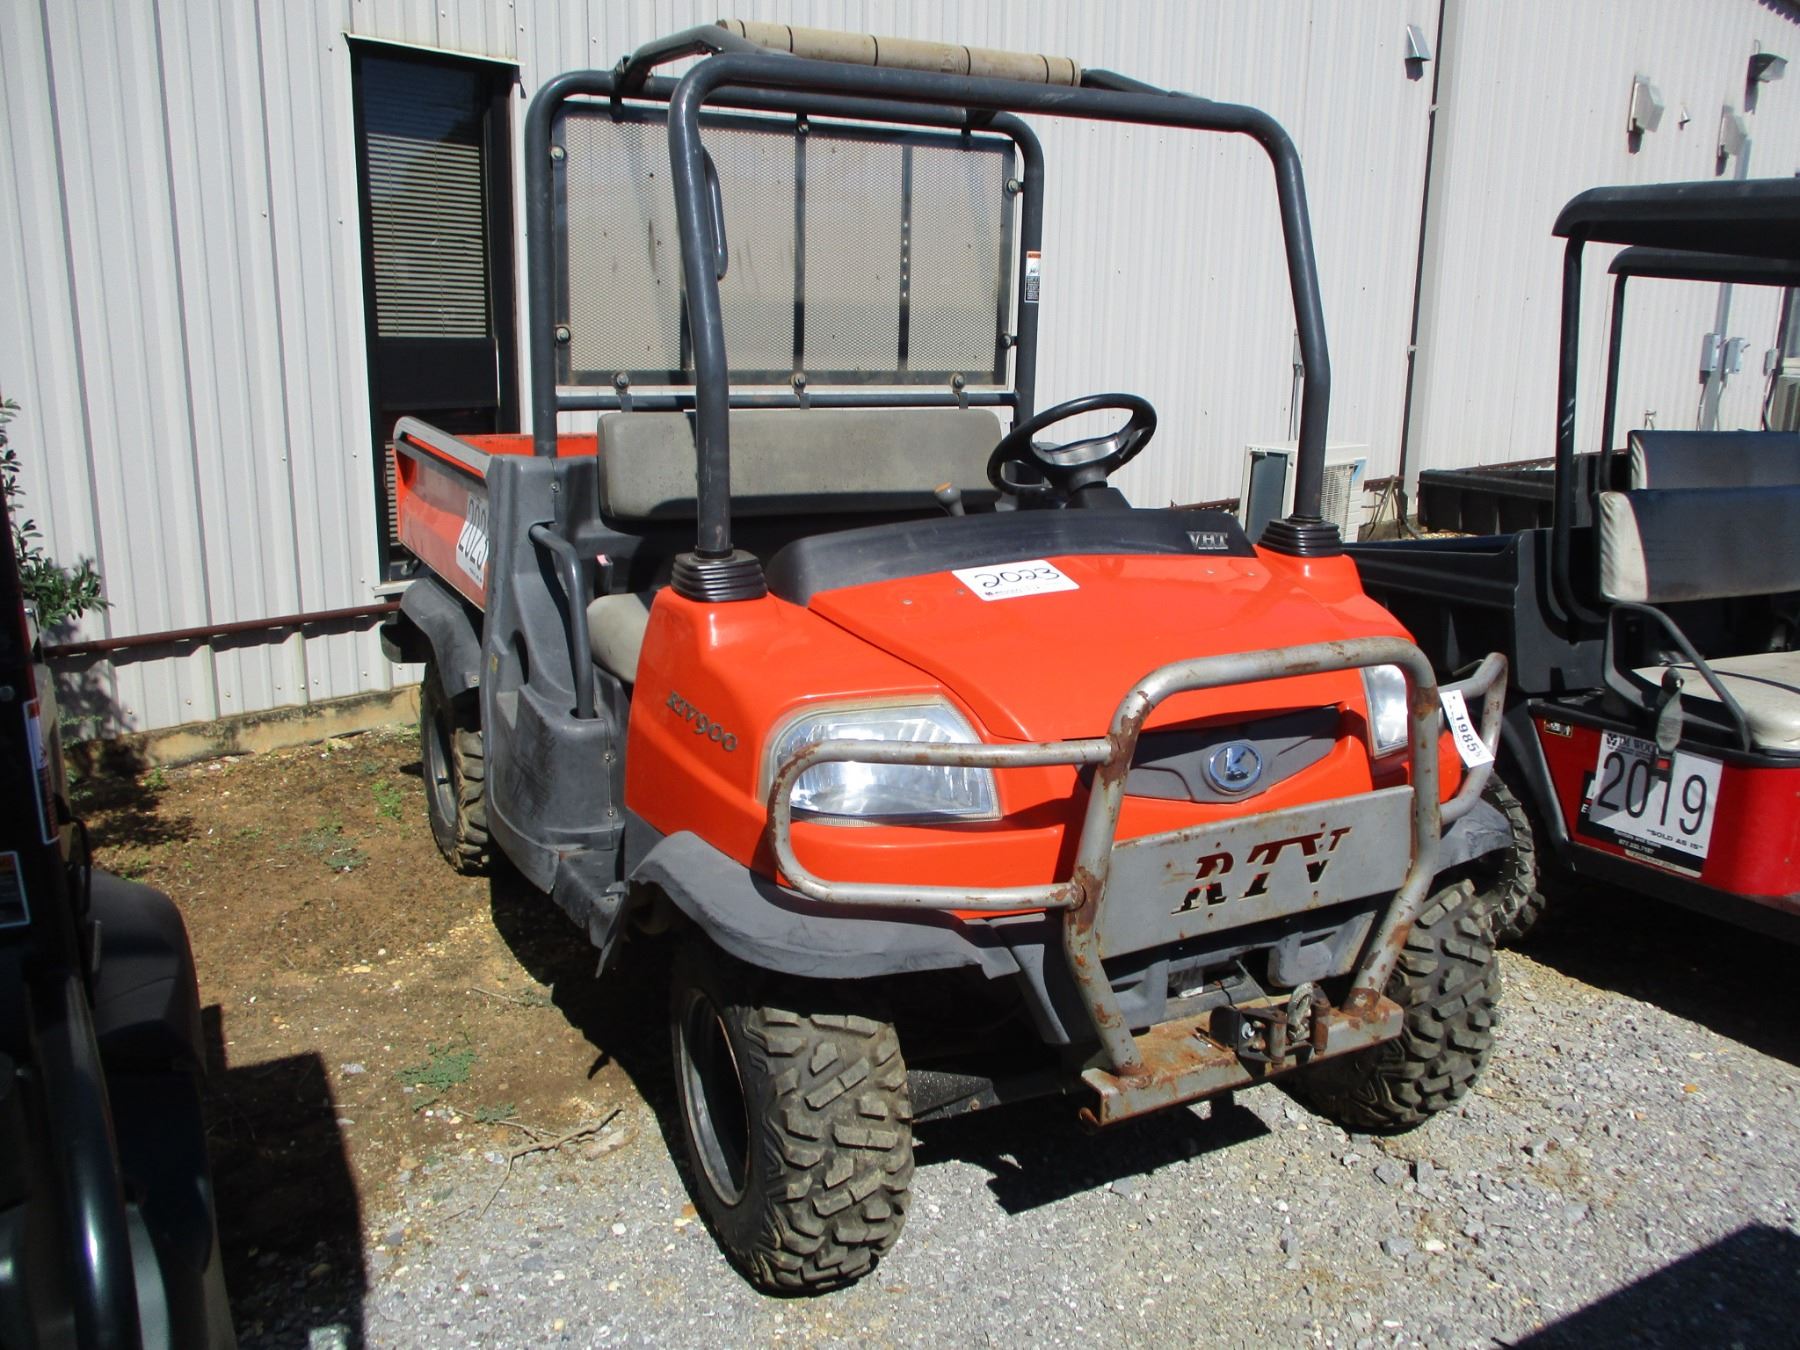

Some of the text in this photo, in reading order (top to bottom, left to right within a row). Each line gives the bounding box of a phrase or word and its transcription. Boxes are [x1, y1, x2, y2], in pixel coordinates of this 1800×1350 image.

[1185, 530, 1229, 549] VHT
[974, 567, 1060, 588] 2023
[666, 689, 738, 752] RTV900
[1455, 713, 1480, 752] 1985
[1597, 751, 1708, 836] 2019
[1170, 826, 1353, 915] RTV
